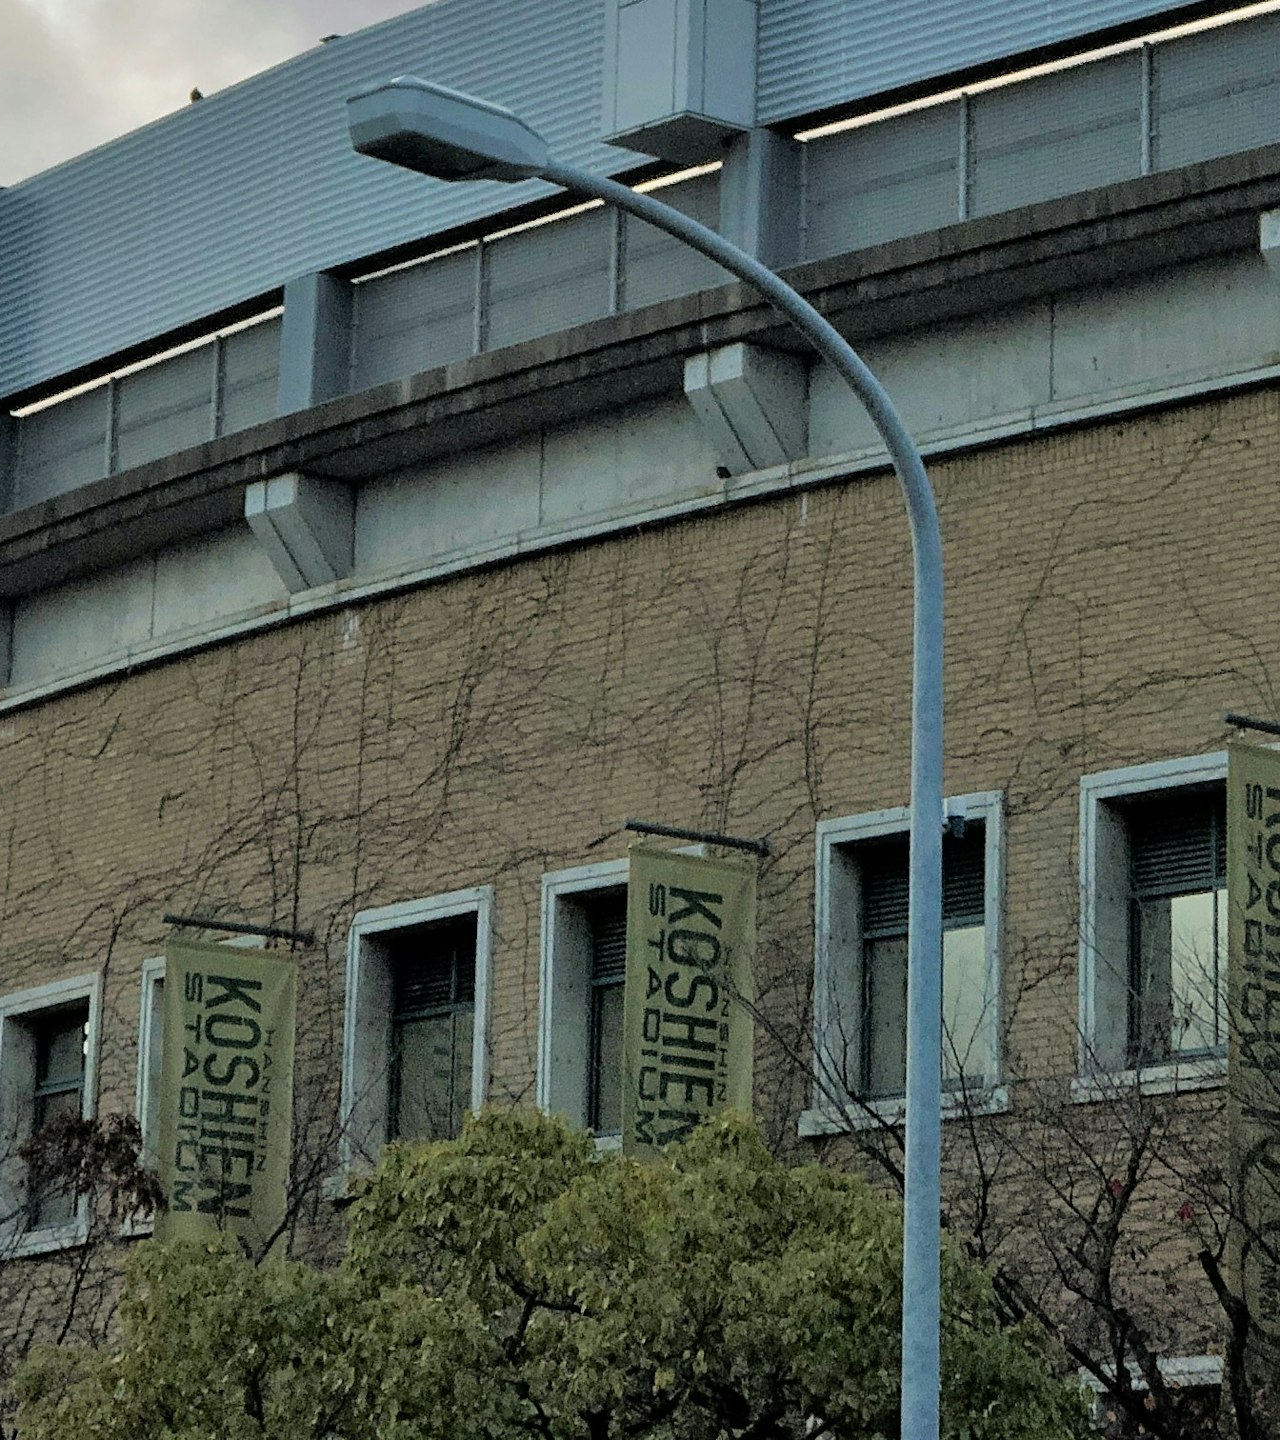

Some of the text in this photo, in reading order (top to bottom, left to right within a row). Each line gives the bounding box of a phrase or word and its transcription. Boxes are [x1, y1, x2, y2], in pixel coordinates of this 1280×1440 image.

[173, 972, 203, 1212] STADIUM
[199, 975, 263, 1219] KOSHIEN
[635, 883, 666, 1145] STADIUM
